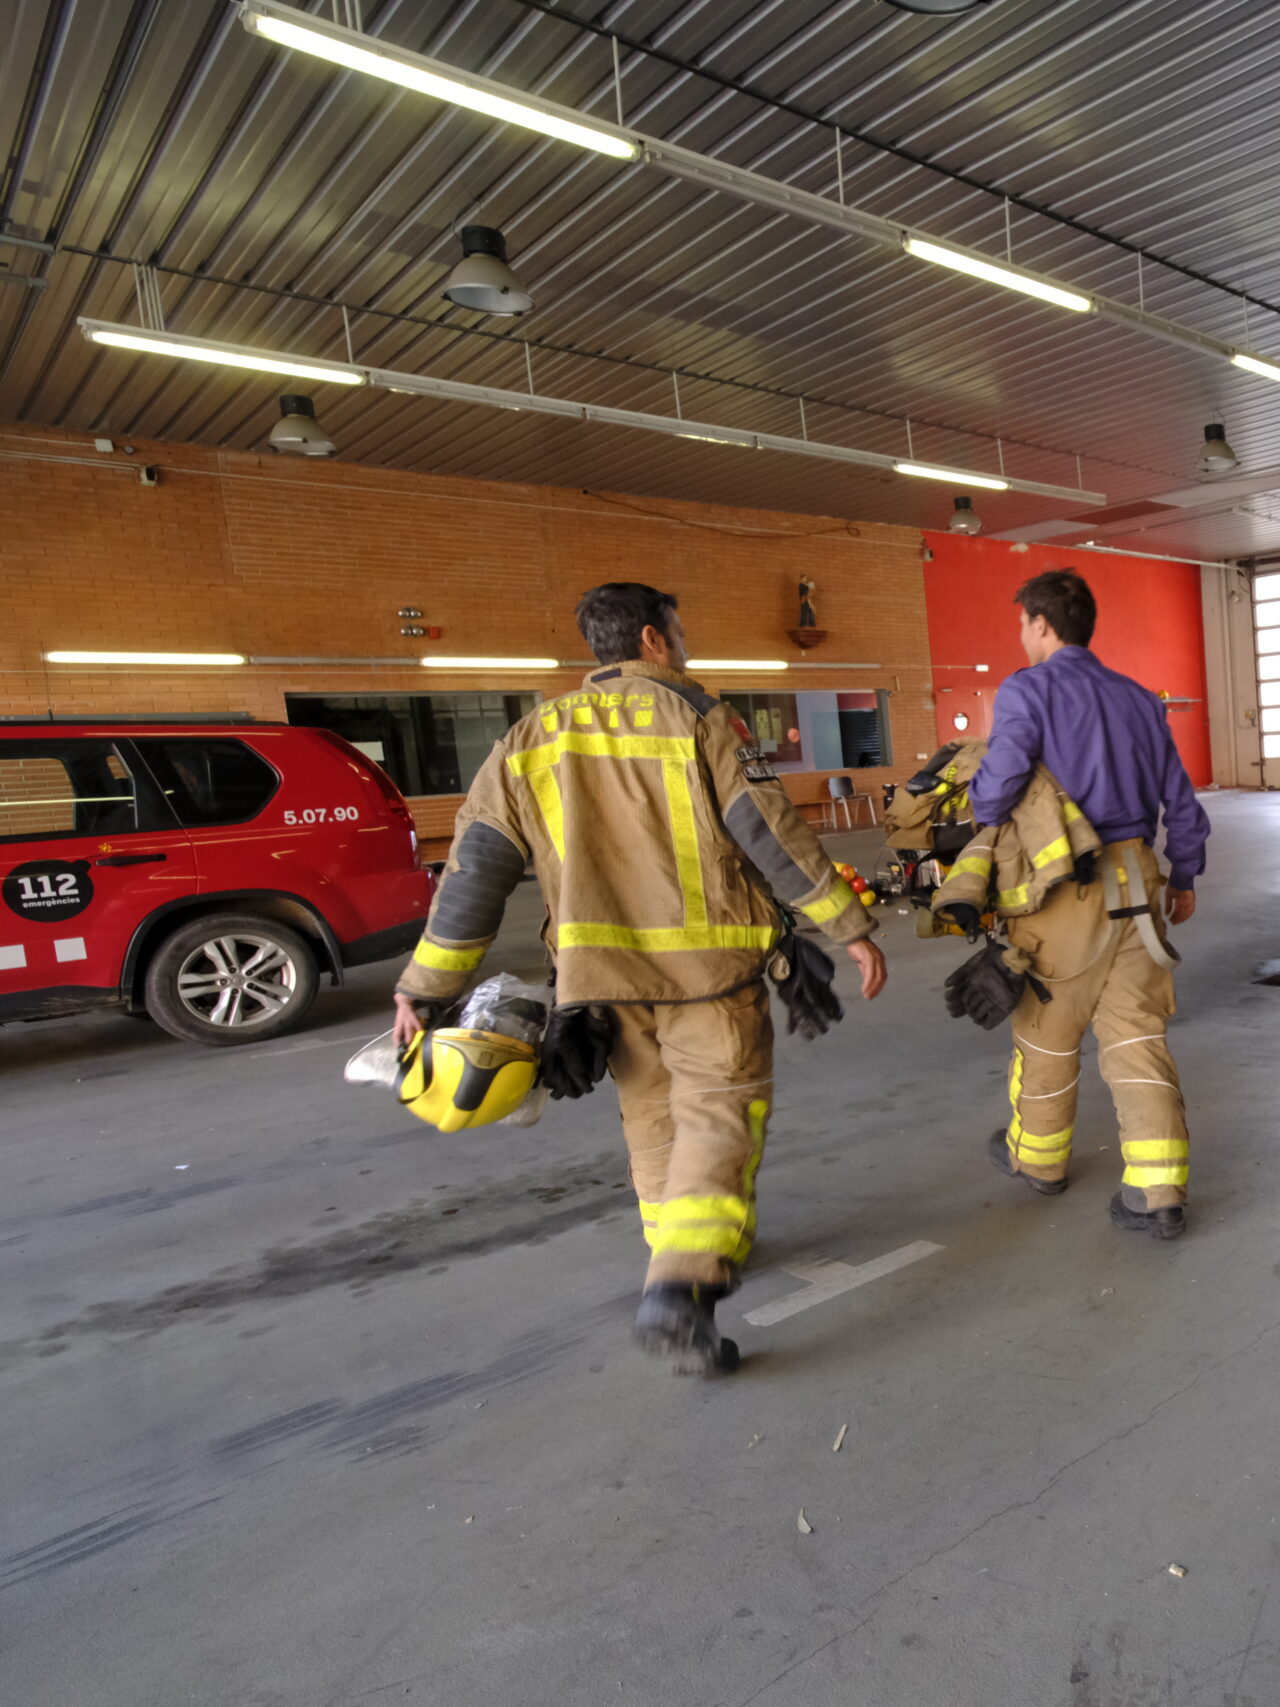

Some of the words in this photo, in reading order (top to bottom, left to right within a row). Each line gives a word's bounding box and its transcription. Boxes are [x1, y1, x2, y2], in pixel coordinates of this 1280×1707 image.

[284, 806, 359, 825] 5.07.90
[18, 873, 79, 899] 112
[22, 897, 80, 909] emergències
